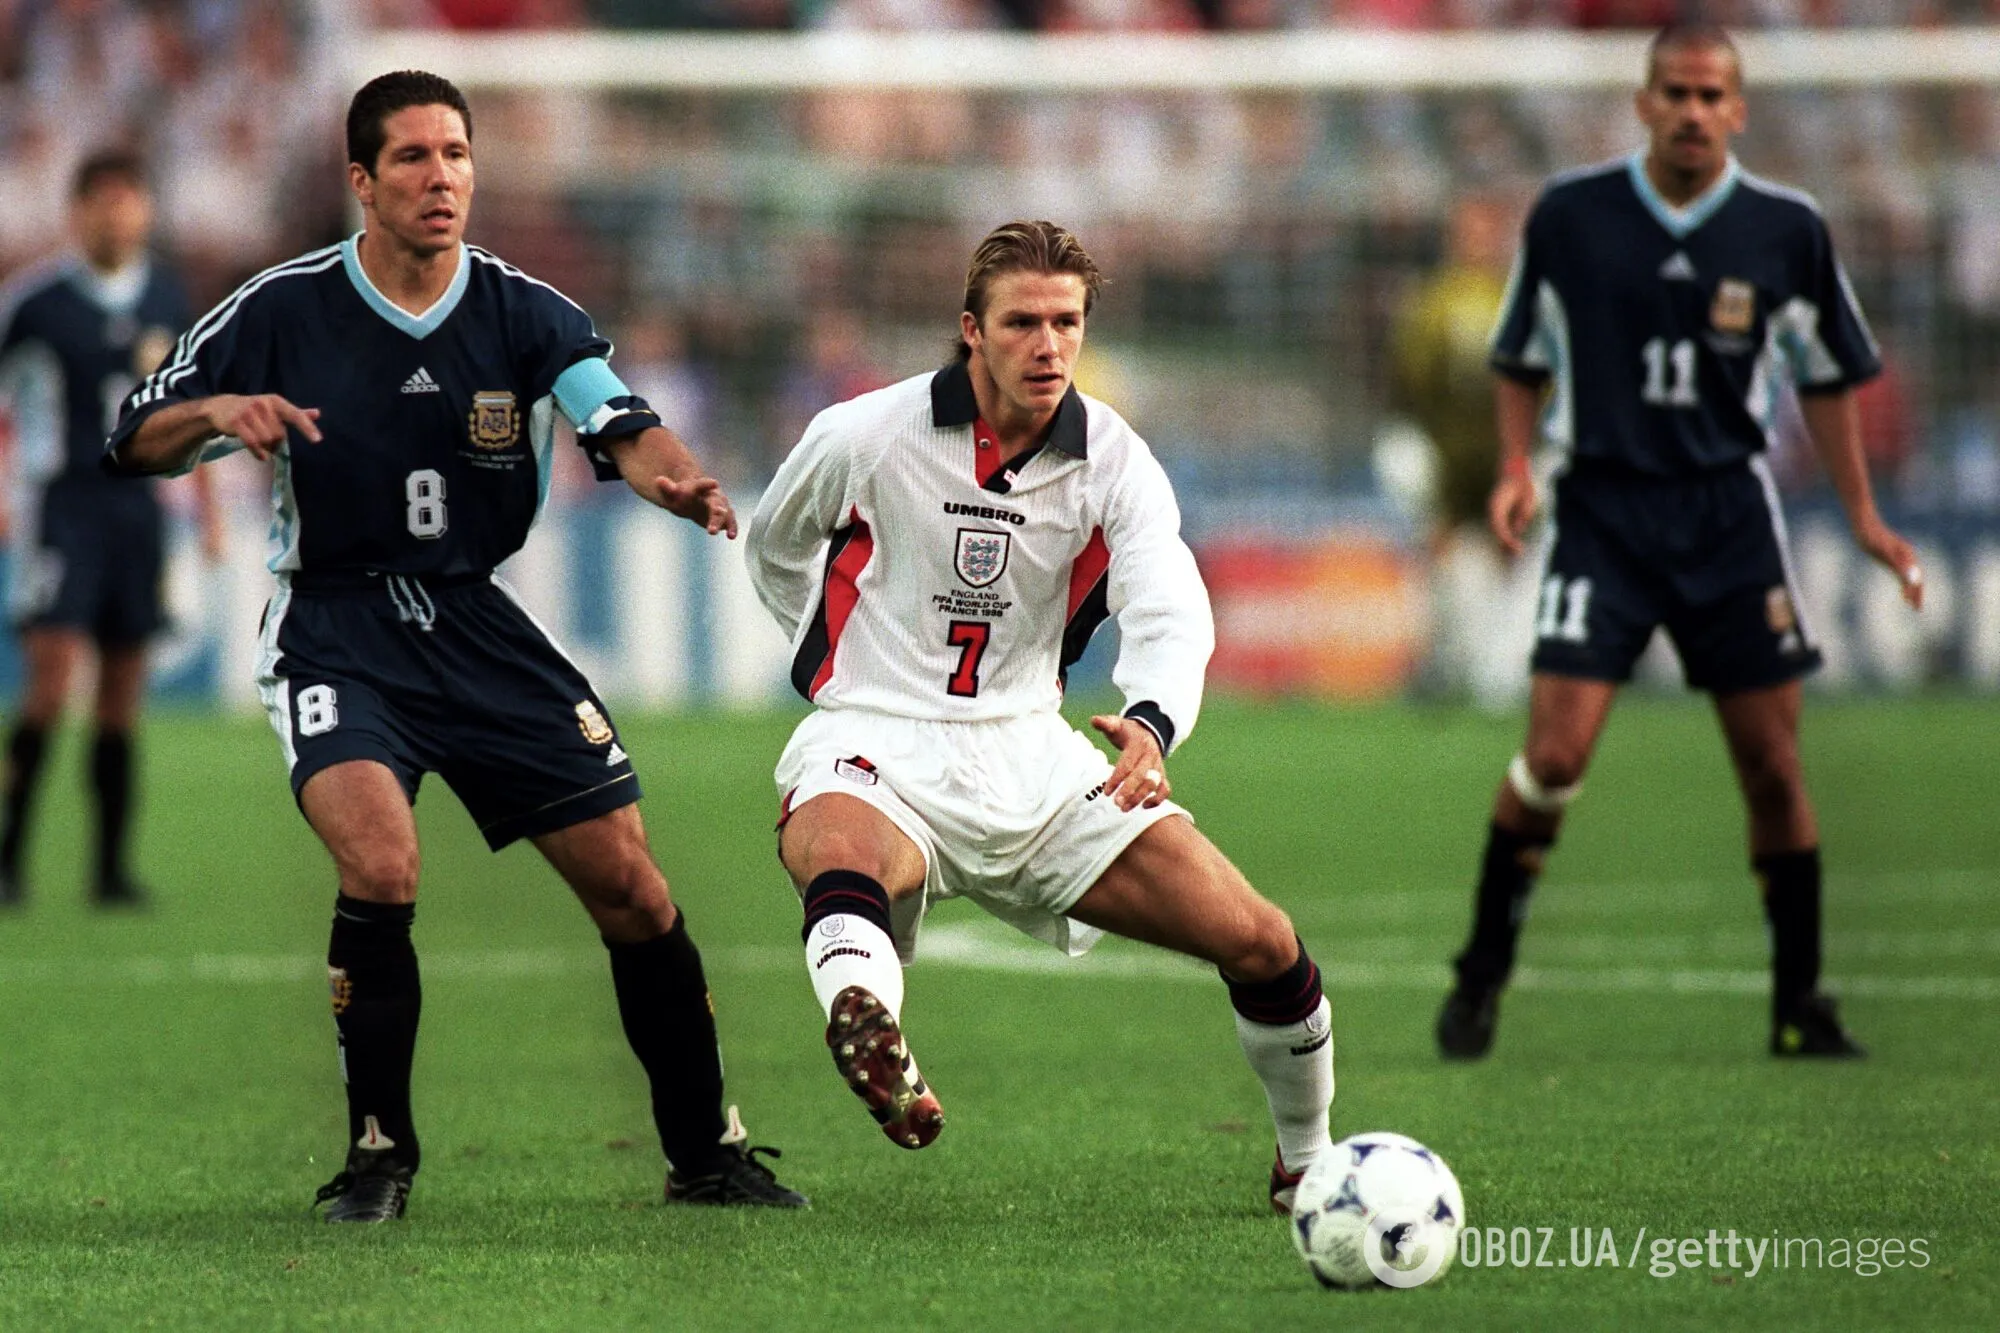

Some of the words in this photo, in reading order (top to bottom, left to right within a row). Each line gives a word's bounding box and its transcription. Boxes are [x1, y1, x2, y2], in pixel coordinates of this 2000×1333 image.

[1641, 337, 1697, 405] 11
[400, 383, 440, 394] adidas
[405, 469, 448, 540] 8
[943, 501, 1026, 526] UMBRO
[932, 594, 953, 605] FIFA
[955, 598, 990, 609] WORLD
[992, 601, 1013, 610] CUP
[951, 589, 999, 601] ENGLAND
[938, 604, 978, 616] FRANCE
[981, 608, 1004, 617] 1998
[1536, 573, 1594, 643] 11
[946, 619, 991, 698] 7
[296, 684, 338, 737] 8
[816, 947, 872, 970] UMBRO
